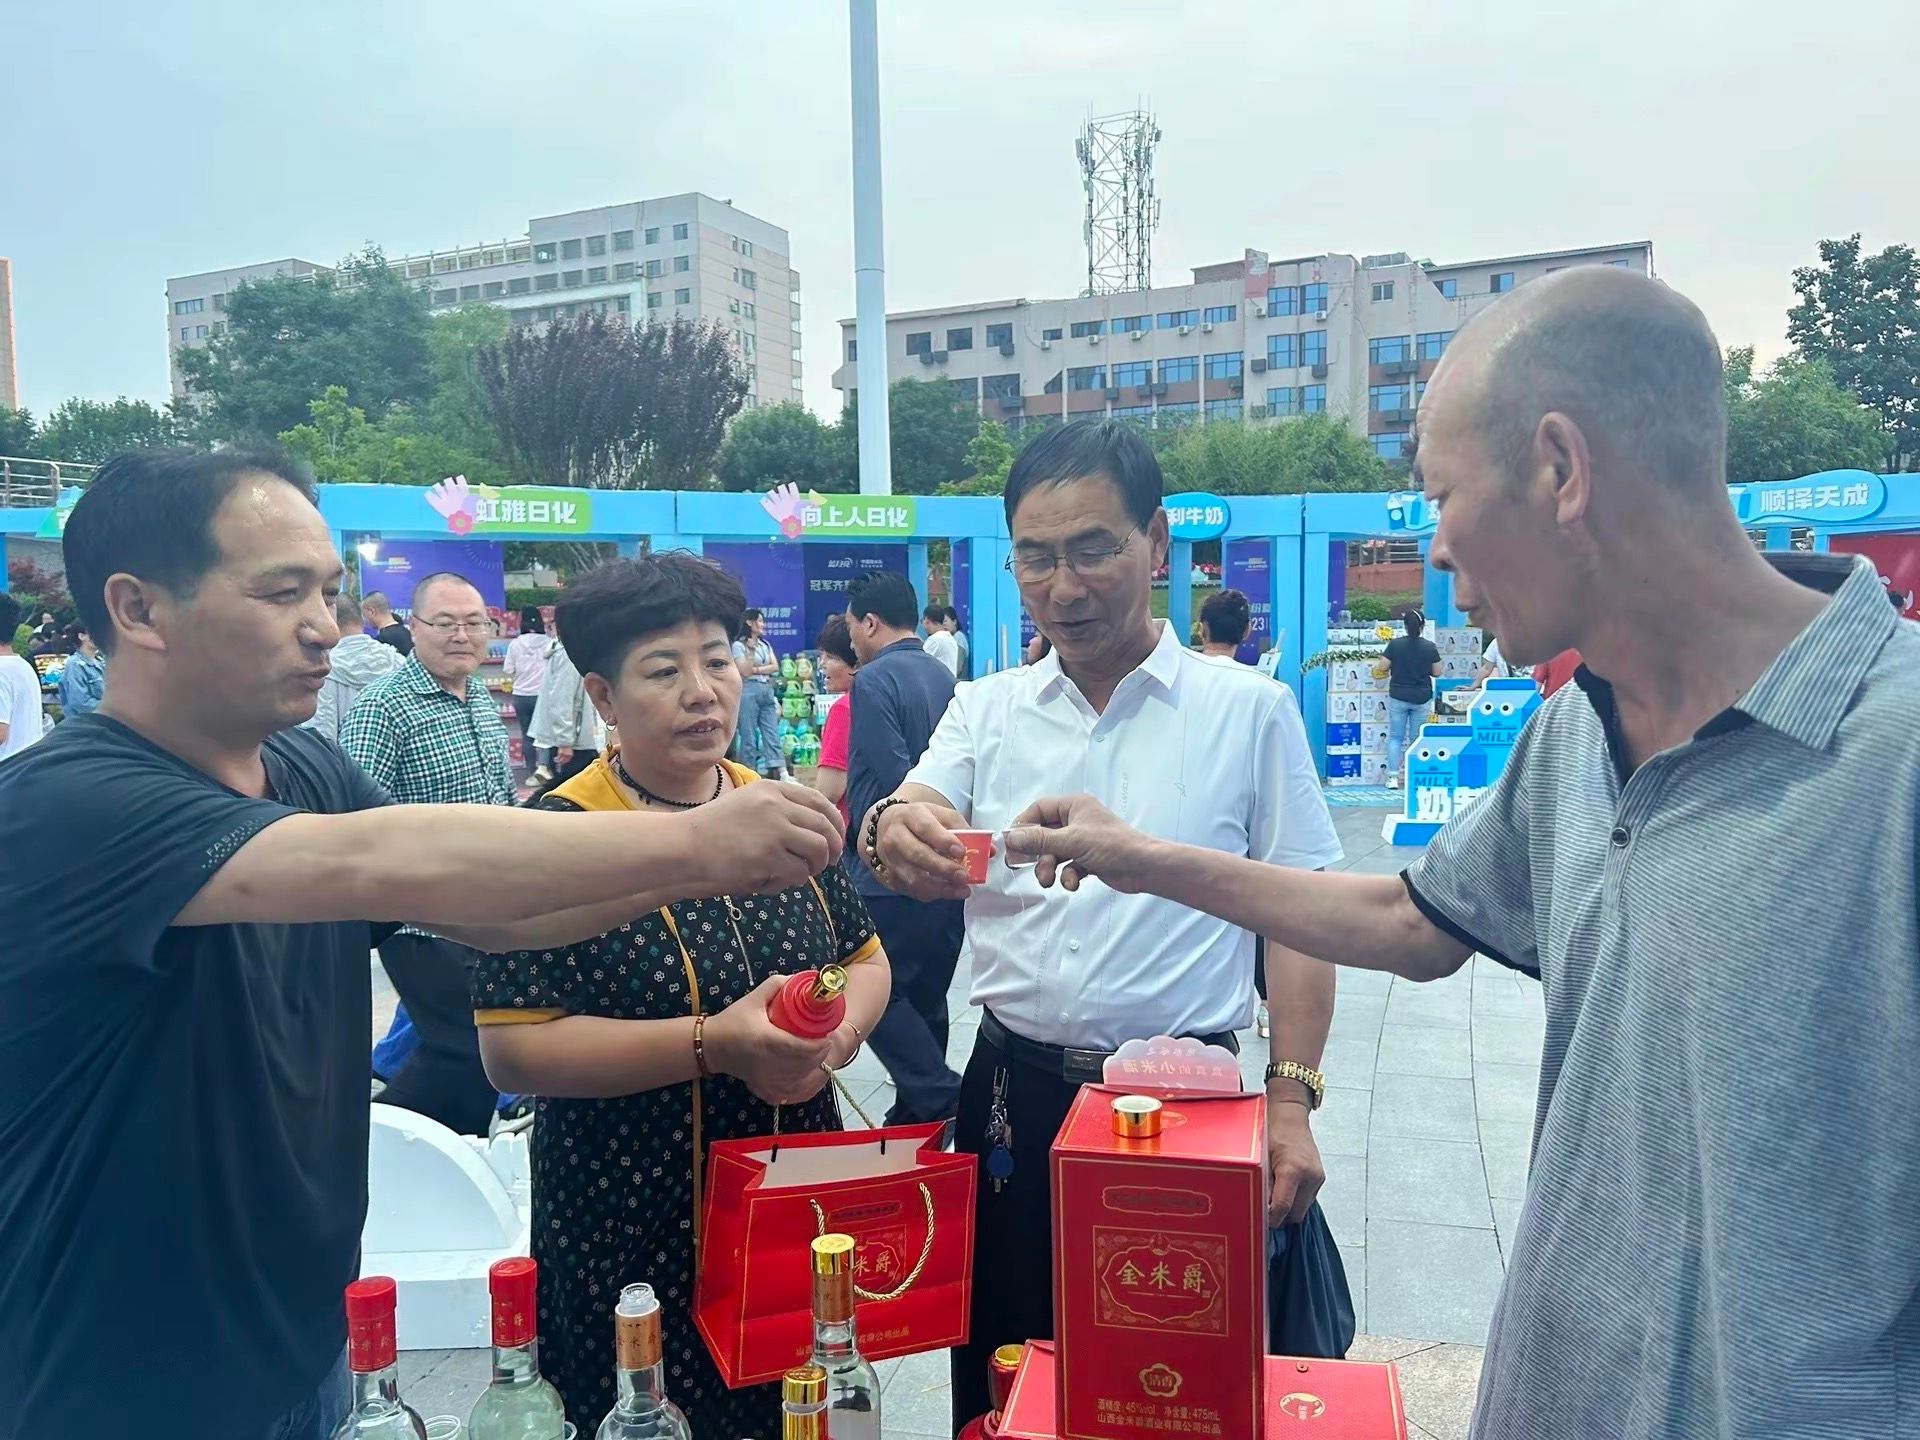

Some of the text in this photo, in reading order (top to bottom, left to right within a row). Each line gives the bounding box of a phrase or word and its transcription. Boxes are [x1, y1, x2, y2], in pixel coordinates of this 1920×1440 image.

[1760, 483, 1868, 512] 顺泽天成
[475, 500, 577, 524] 虹雅日化
[801, 506, 908, 528] 向上人日化
[1477, 731, 1515, 743] MILK
[1414, 776, 1453, 787] MILK
[854, 1250, 891, 1277] 米爵
[1115, 1259, 1206, 1293] 金米爵
